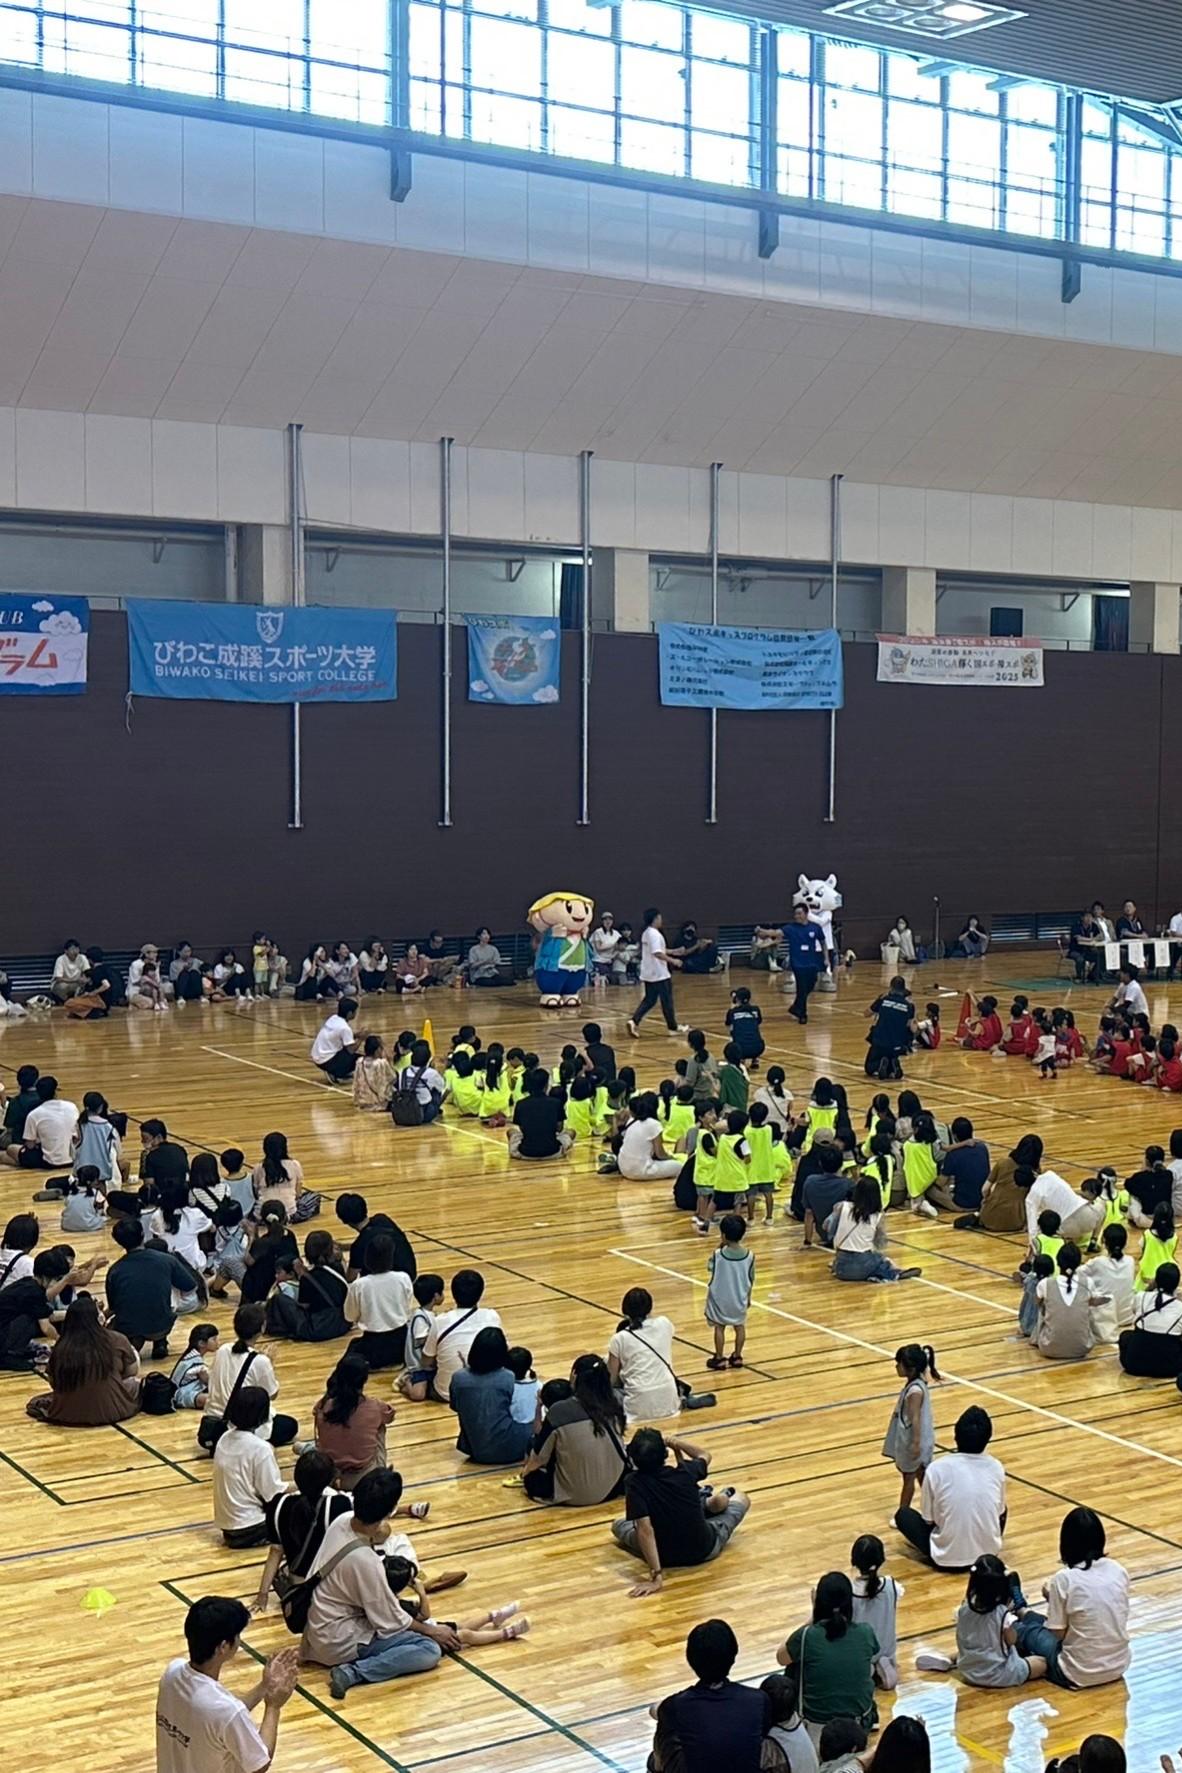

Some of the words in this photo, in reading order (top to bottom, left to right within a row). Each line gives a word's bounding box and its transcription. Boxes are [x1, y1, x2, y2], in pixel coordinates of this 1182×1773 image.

[153, 640, 376, 670] びわこ成蹊スポーツ大学
[155, 664, 211, 678] BIWAKO
[214, 668, 263, 682] SEIKEI
[268, 670, 314, 683] SPORT
[317, 669, 376, 681] COLLEGE
